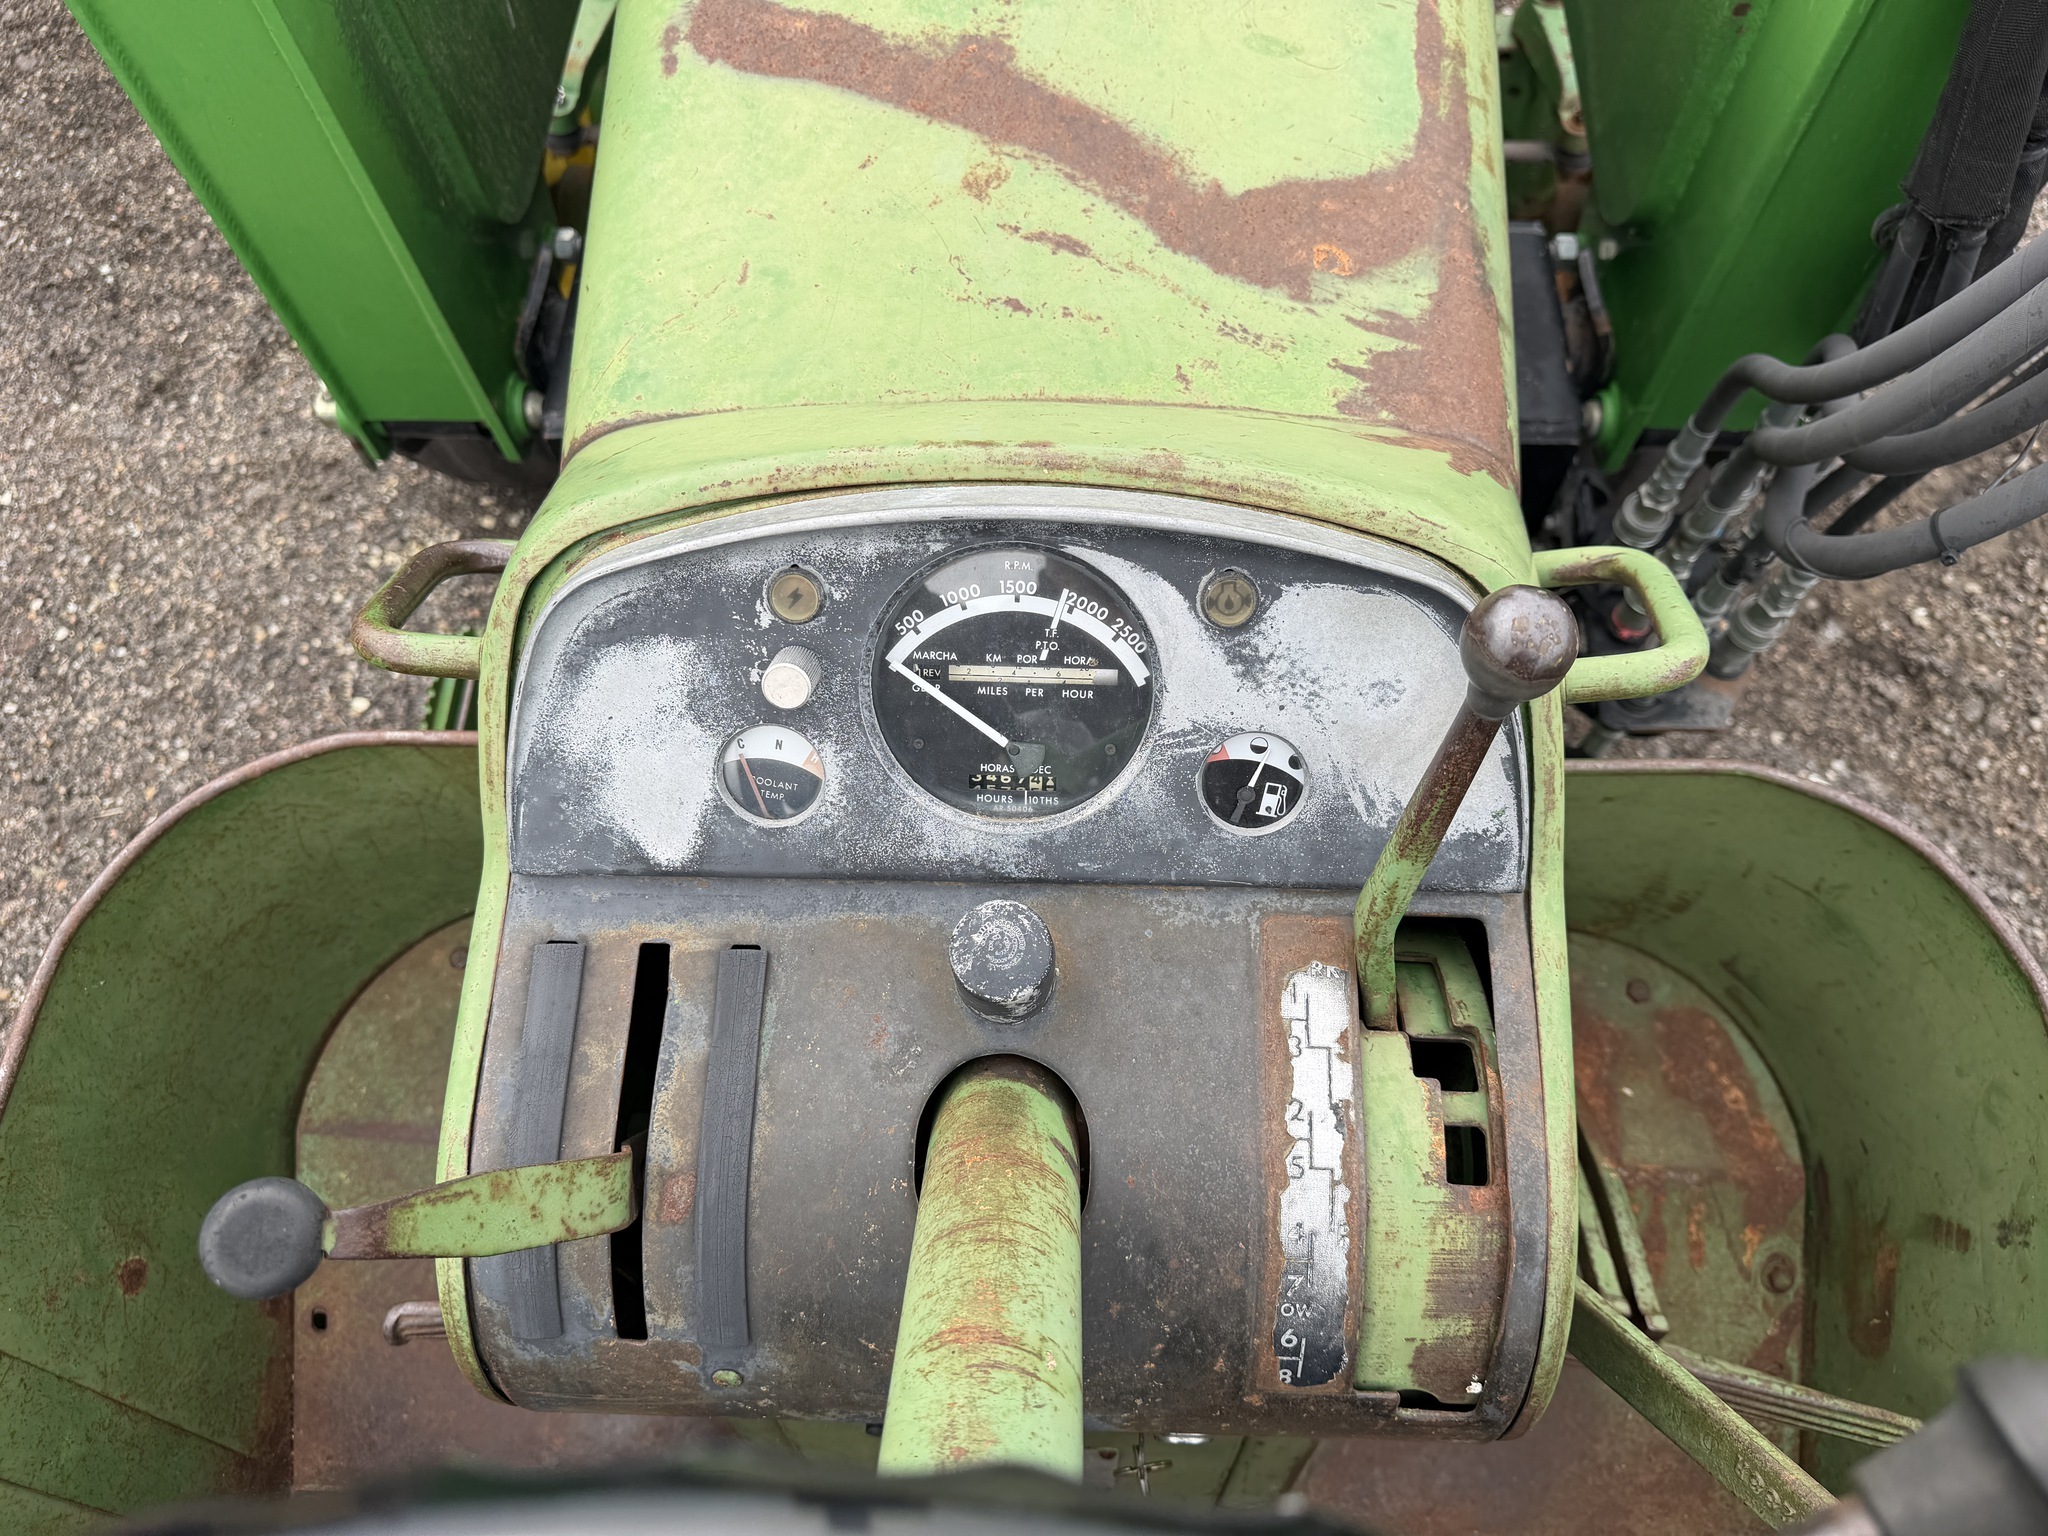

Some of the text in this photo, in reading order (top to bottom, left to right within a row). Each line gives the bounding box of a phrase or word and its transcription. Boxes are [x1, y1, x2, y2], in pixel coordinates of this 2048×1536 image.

[1004, 561, 1034, 571] R.P.M.
[895, 580, 1147, 654] 500 1000 1500 2000 2500
[912, 651, 958, 660] MARCHA
[985, 653, 1002, 663] KM
[1017, 654, 1038, 664] POR
[923, 668, 941, 677] REV
[912, 684, 941, 692] GER
[976, 686, 1094, 699] MILES PER HOUR
[737, 738, 745, 749] C
[775, 739, 783, 750] N
[980, 763, 1015, 773] HORAS
[976, 794, 1013, 804] HOURS
[1288, 1100, 1304, 1122] 2
[1289, 1155, 1304, 1179] 5
[1287, 1274, 1304, 1296] 7
[1280, 1328, 1298, 1347] 6
